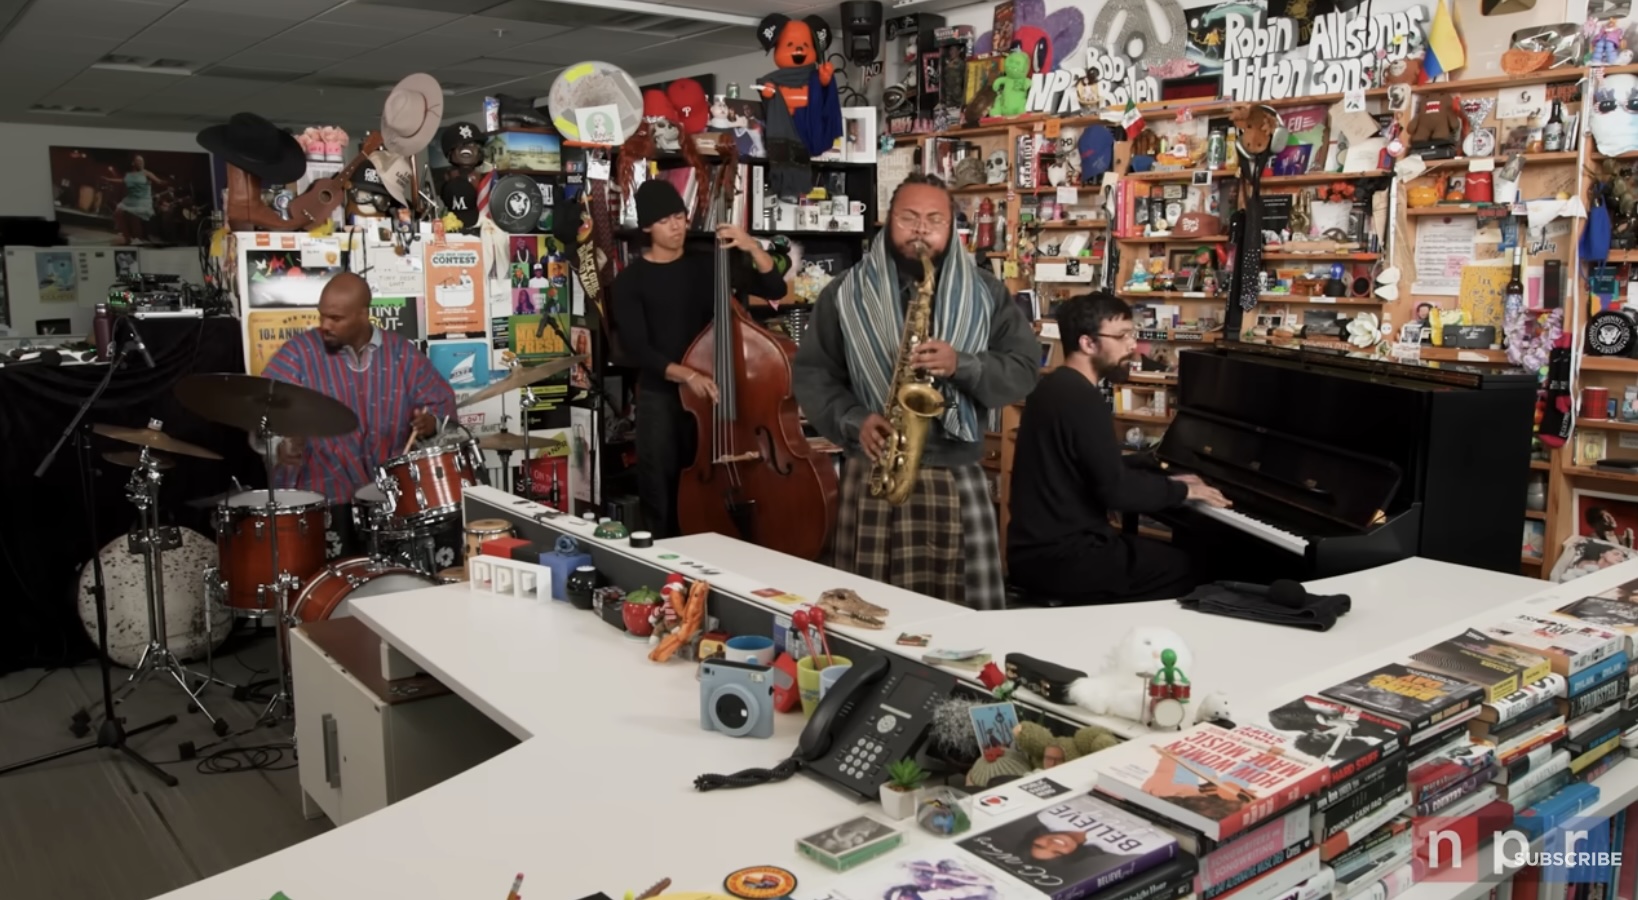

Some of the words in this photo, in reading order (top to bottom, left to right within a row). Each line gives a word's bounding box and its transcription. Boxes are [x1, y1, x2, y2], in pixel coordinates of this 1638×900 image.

[1225, 10, 1294, 60] Robin
[1308, 5, 1424, 63] Allsongs
[1087, 44, 1125, 83] Bob
[1223, 53, 1308, 101] Hilton
[1025, 67, 1087, 113] NPR
[1098, 65, 1159, 108] Boilen
[451, 195, 469, 211] M
[432, 256, 477, 265] CONTEST
[515, 340, 564, 354] FRESH
[1164, 740, 1238, 773] WOMEN
[1184, 730, 1252, 758] MUSIC
[1230, 763, 1286, 790] HOW
[1242, 751, 1307, 779] MADE
[1332, 763, 1355, 782] HARD
[1355, 750, 1380, 770] STUFF
[1049, 804, 1143, 852] BELIEVE
[1355, 804, 1371, 820] CASH
[1214, 841, 1276, 879] SONGWRITING
